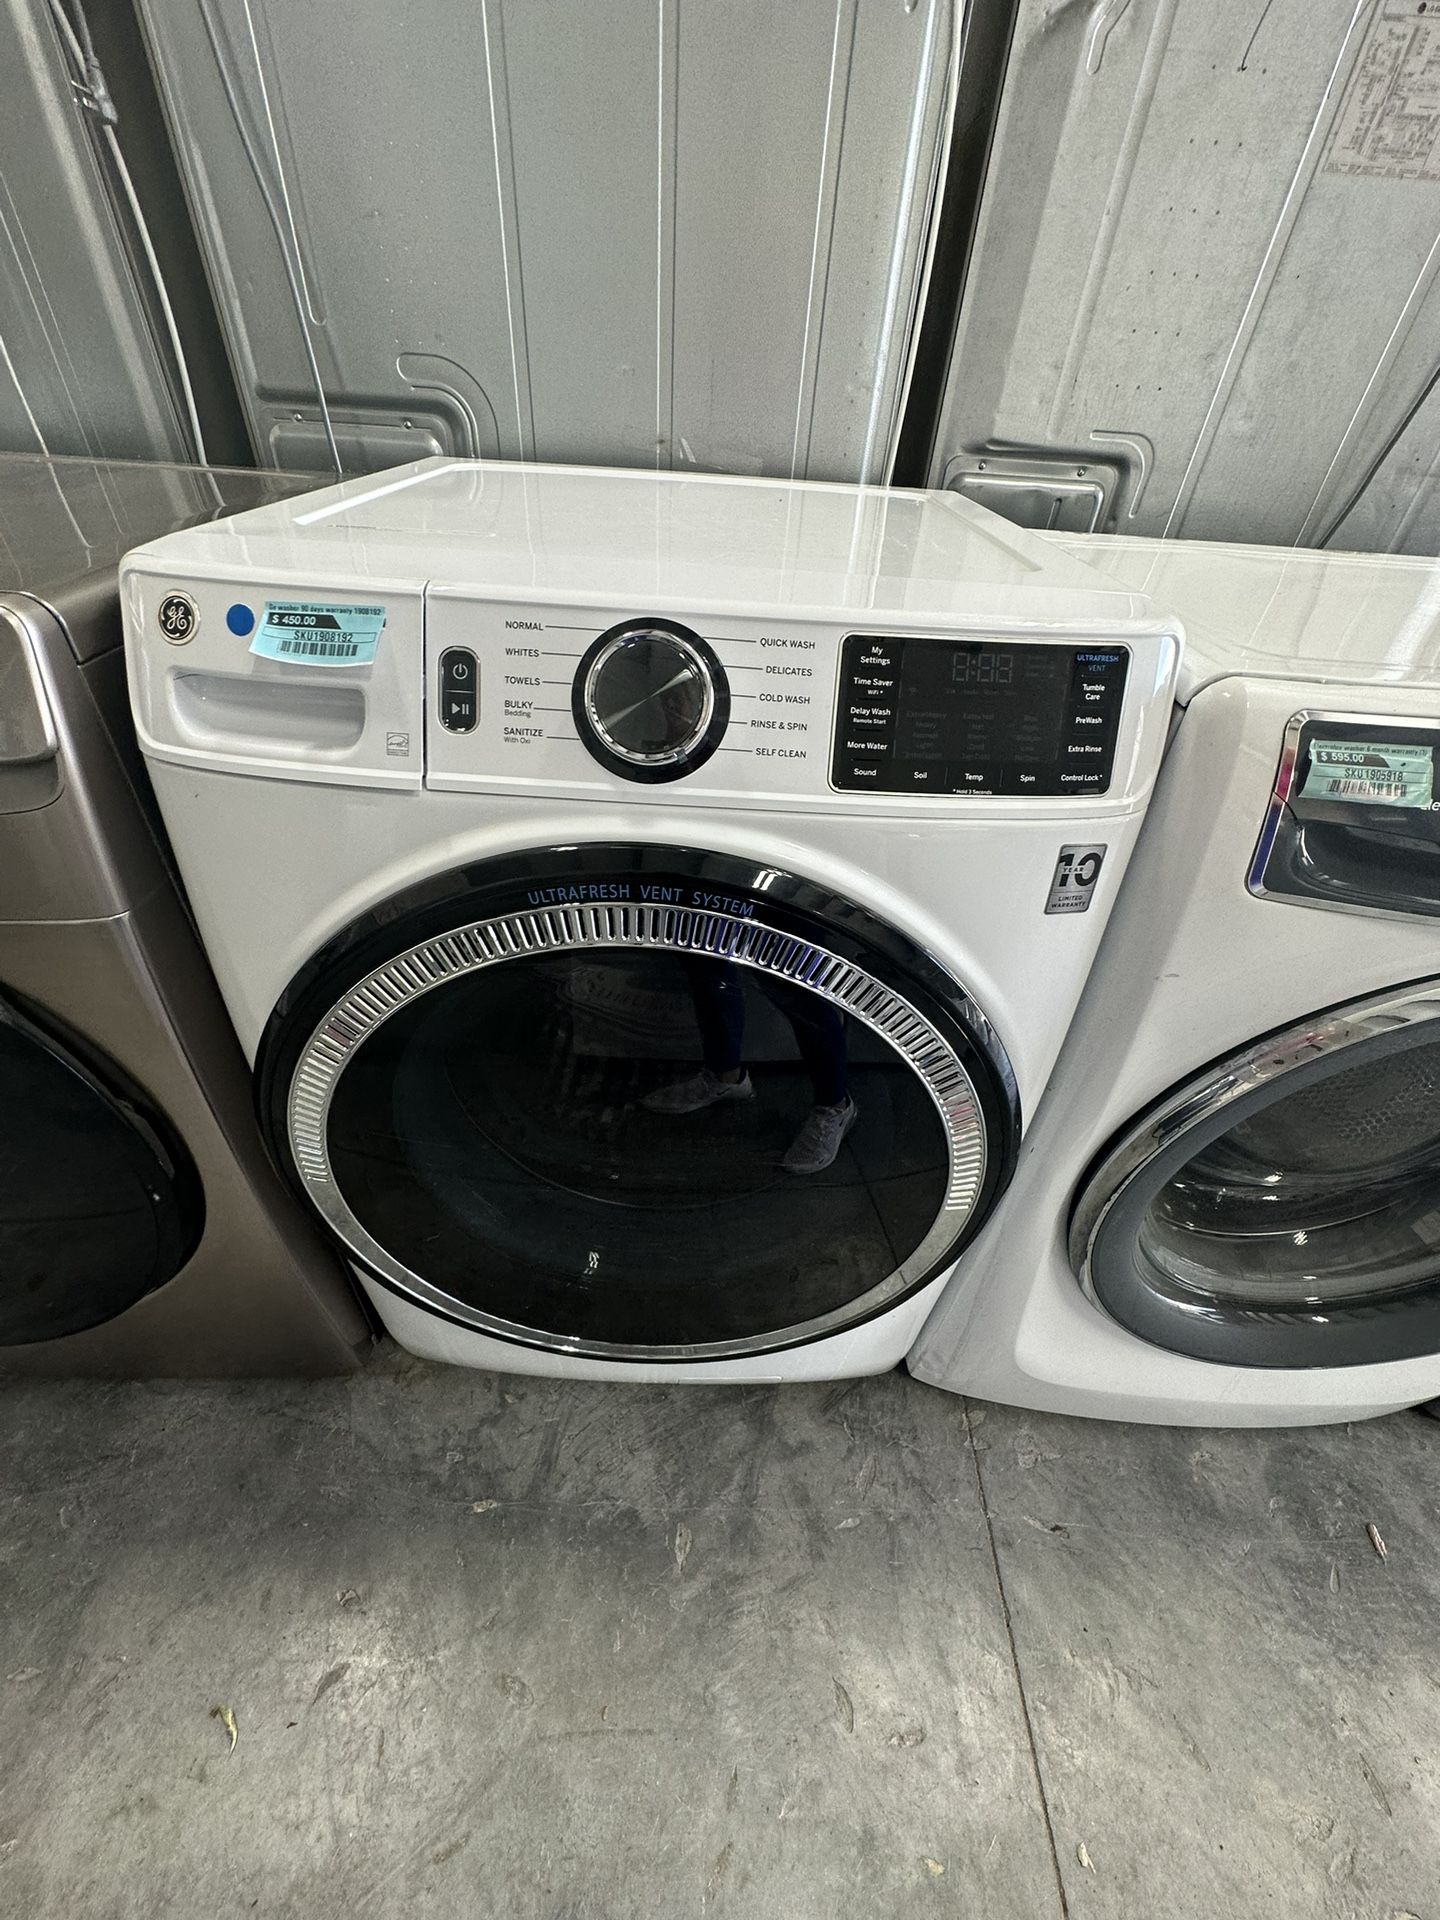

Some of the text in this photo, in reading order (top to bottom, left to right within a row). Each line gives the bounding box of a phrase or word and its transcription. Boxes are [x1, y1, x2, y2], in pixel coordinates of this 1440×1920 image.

[278, 604, 300, 612] washer
[310, 606, 324, 614] days
[325, 607, 353, 615] warranty
[354, 607, 382, 616] 1908192
[271, 614, 317, 625] $ 450.00
[505, 620, 544, 631] NORMAL
[293, 630, 353, 643] SKU1908192
[760, 637, 816, 650] QUICK WASH
[505, 647, 540, 658] WHITES
[871, 646, 884, 656] My
[860, 655, 891, 666] Settings
[1076, 654, 1119, 663] ULTRAFRESH
[765, 666, 813, 677] DELICATES
[1087, 664, 1106, 672] VENT
[504, 675, 541, 686] TOWELS
[853, 677, 893, 687] Time Saver
[1082, 683, 1106, 692] Tumble
[759, 693, 810, 705] COLD WASH
[1085, 692, 1101, 701] Care
[504, 700, 533, 710] BULKY
[504, 709, 532, 719] Bedding
[850, 706, 891, 717] Delay Wash
[750, 719, 808, 731] RINSE & SPIN
[503, 727, 543, 738] SANITIZE
[504, 736, 531, 744] With Oxi
[847, 741, 888, 750] More Water
[1067, 745, 1102, 753] Extra Rinse
[755, 747, 807, 758] SELF CLEAN
[1320, 751, 1365, 763] $ 595.00
[1391, 748, 1419, 756] warranty
[853, 768, 877, 777] Sound
[913, 771, 928, 779] Soil
[1060, 773, 1082, 782] Control
[964, 773, 984, 783] Temp
[1019, 774, 1035, 783] Spin
[1058, 852, 1102, 887] 10
[527, 884, 754, 916] ULTRAFRESH VENT SYSTEM
[1051, 901, 1086, 909] WARRANTY
